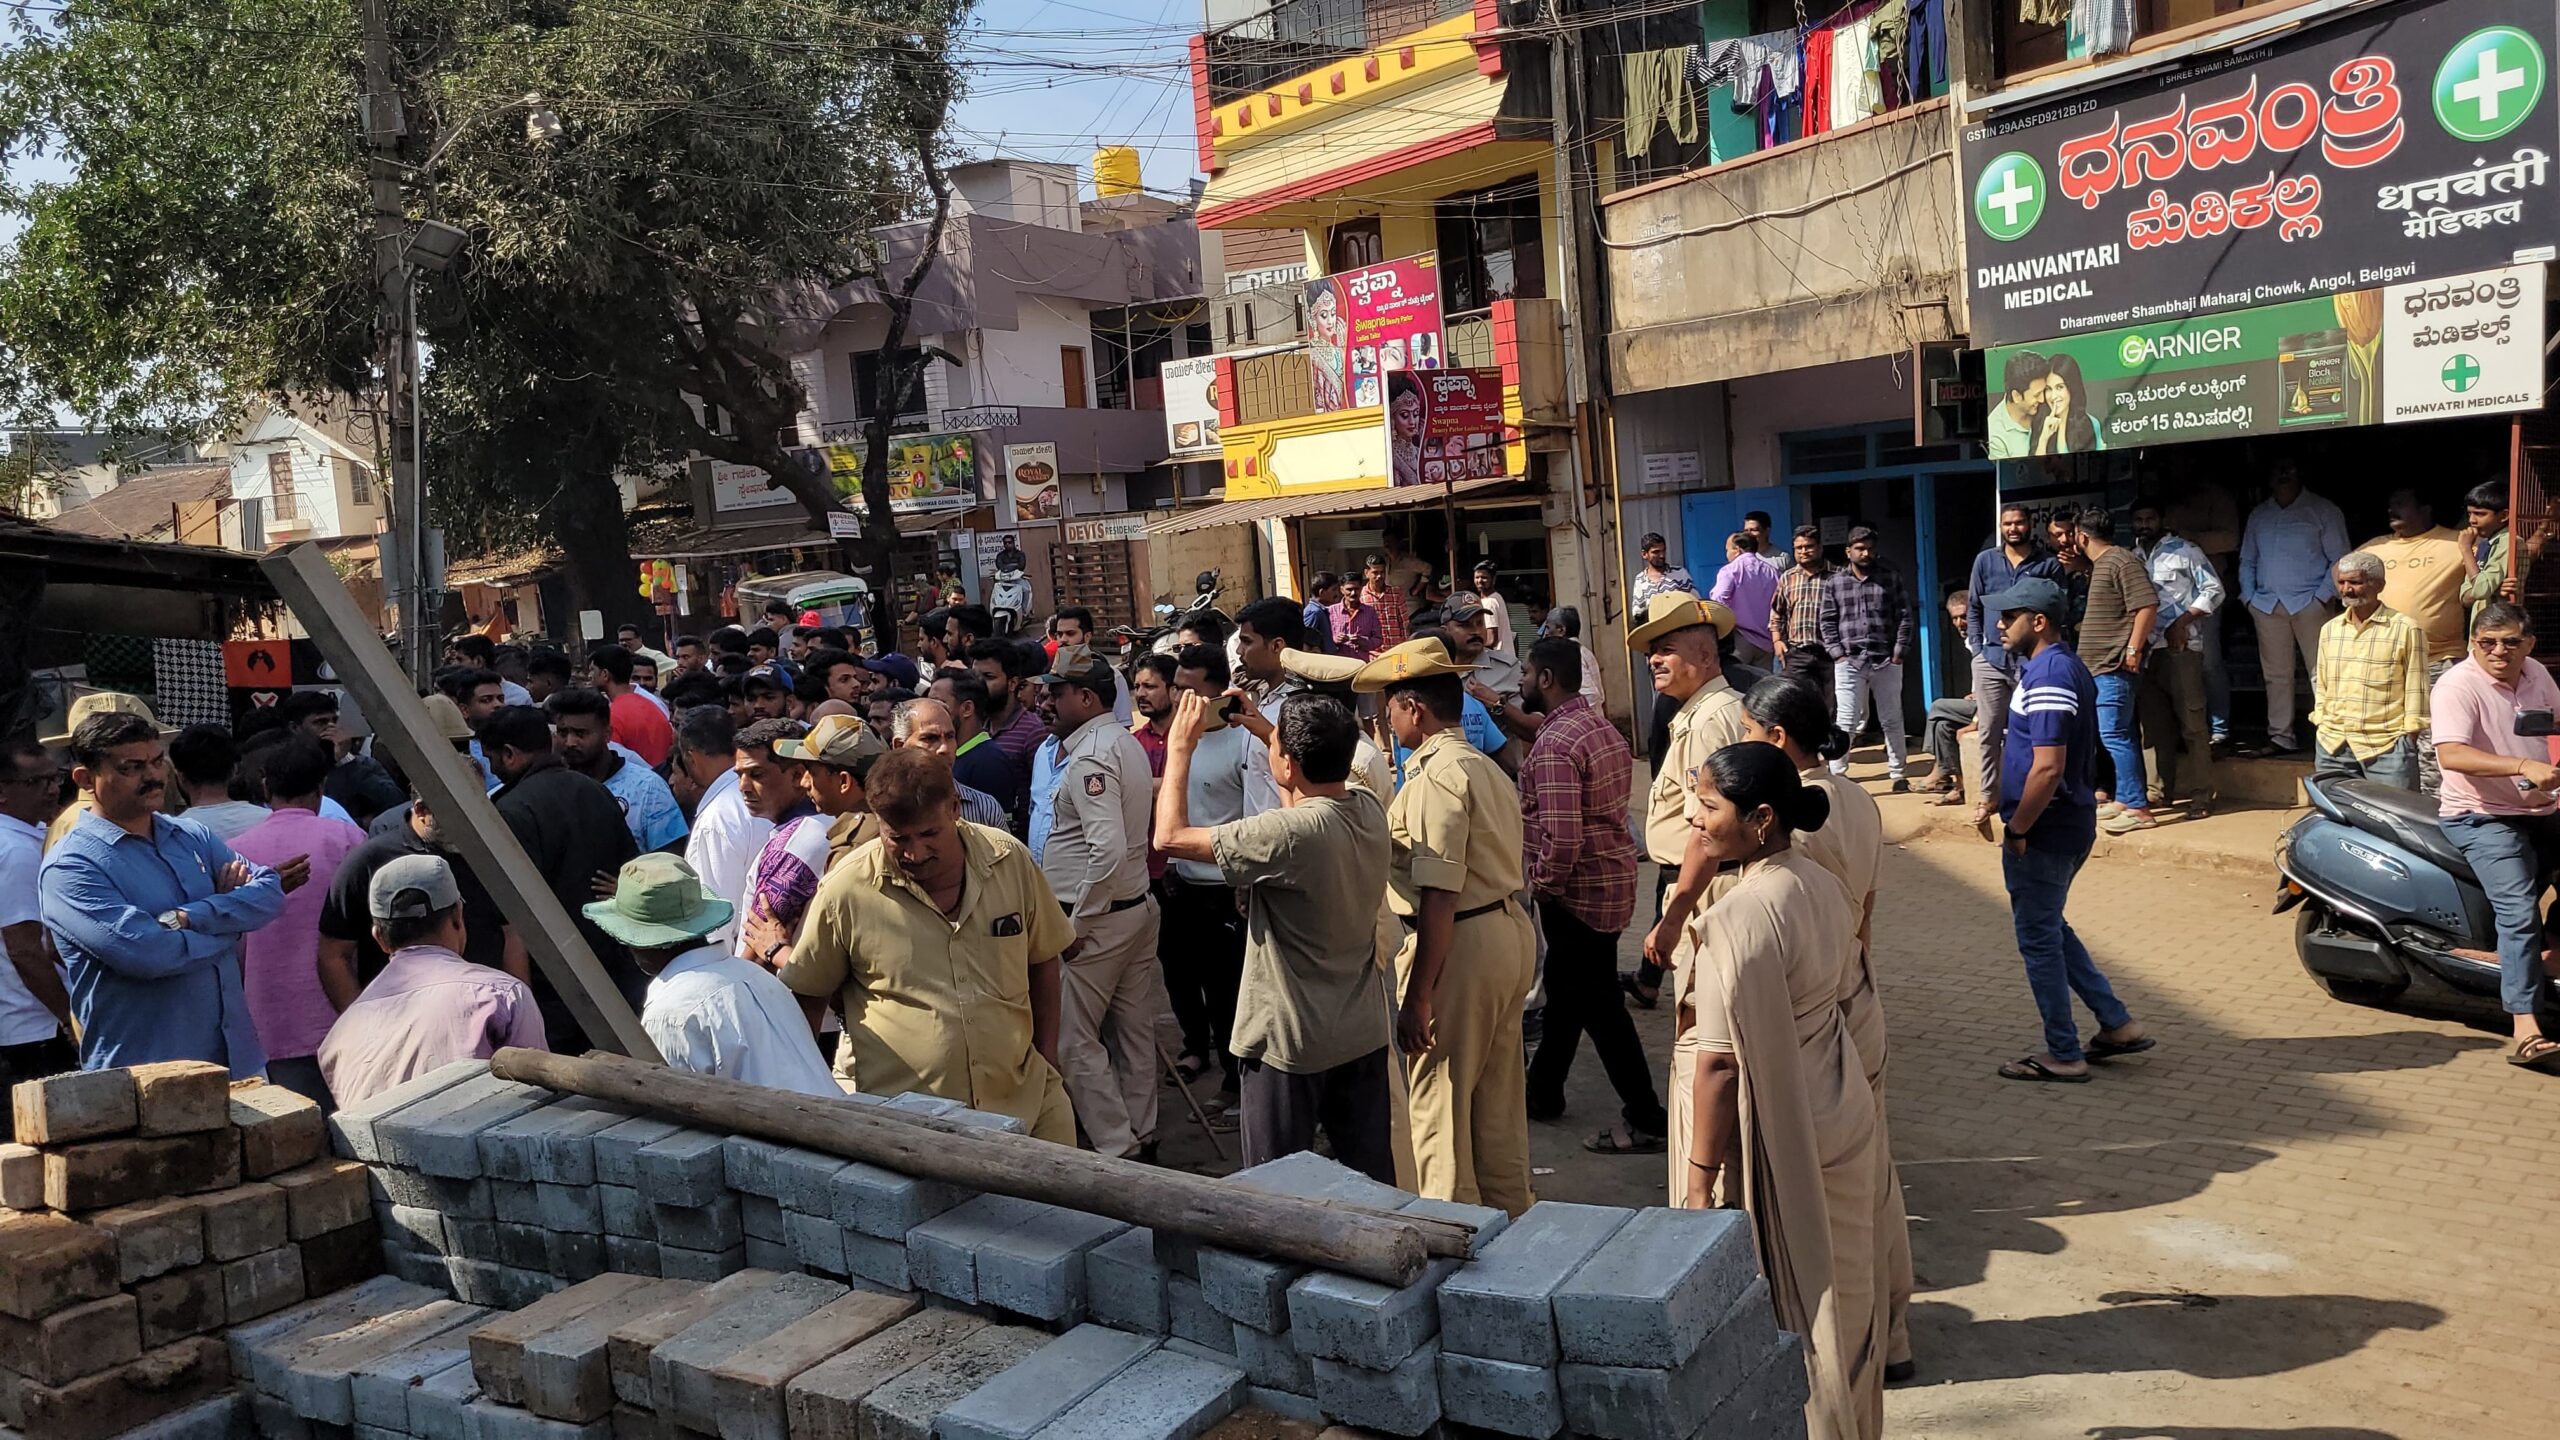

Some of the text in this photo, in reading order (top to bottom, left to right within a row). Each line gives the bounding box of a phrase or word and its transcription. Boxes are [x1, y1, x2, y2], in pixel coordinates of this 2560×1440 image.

[2165, 69, 2193, 84] SHREE
[2194, 60, 2223, 76] SWAMI
[2223, 49, 2266, 68] SAMARTH
[1966, 125, 1997, 142] GSTIN
[2058, 55, 2404, 210] ಧನವಂತ್ರಿ
[2377, 148, 2550, 210] धनवंती
[2402, 200, 2523, 239] मेडिकल
[1977, 243, 2120, 289] DHANVANTARI
[2004, 280, 2094, 310] MEDICAL
[2060, 261, 2416, 330] Dharamveer Shambhaji Maharaj Chowk, Angol, Belgavi
[2404, 277, 2521, 318] ಧನವಂತ್ರಿ
[1355, 317, 1386, 332] Swapna
[2412, 314, 2511, 348] ಮೆಡಿಕಲ್ಸ್
[2119, 326, 2241, 364] GARNIER
[2115, 374, 2247, 411] ನ್ಯಾಚುರಲ್ ಲುಕ್ಕಿಂಗ್
[2396, 393, 2529, 416] DHANVATRI MEDICALS
[1432, 417, 1458, 427] Swapna
[2111, 405, 2253, 434] ಕಲರ್ 15 ನಿಮಿಷದಲ್ಲಿ!
[1018, 468, 1041, 478] ROYAL
